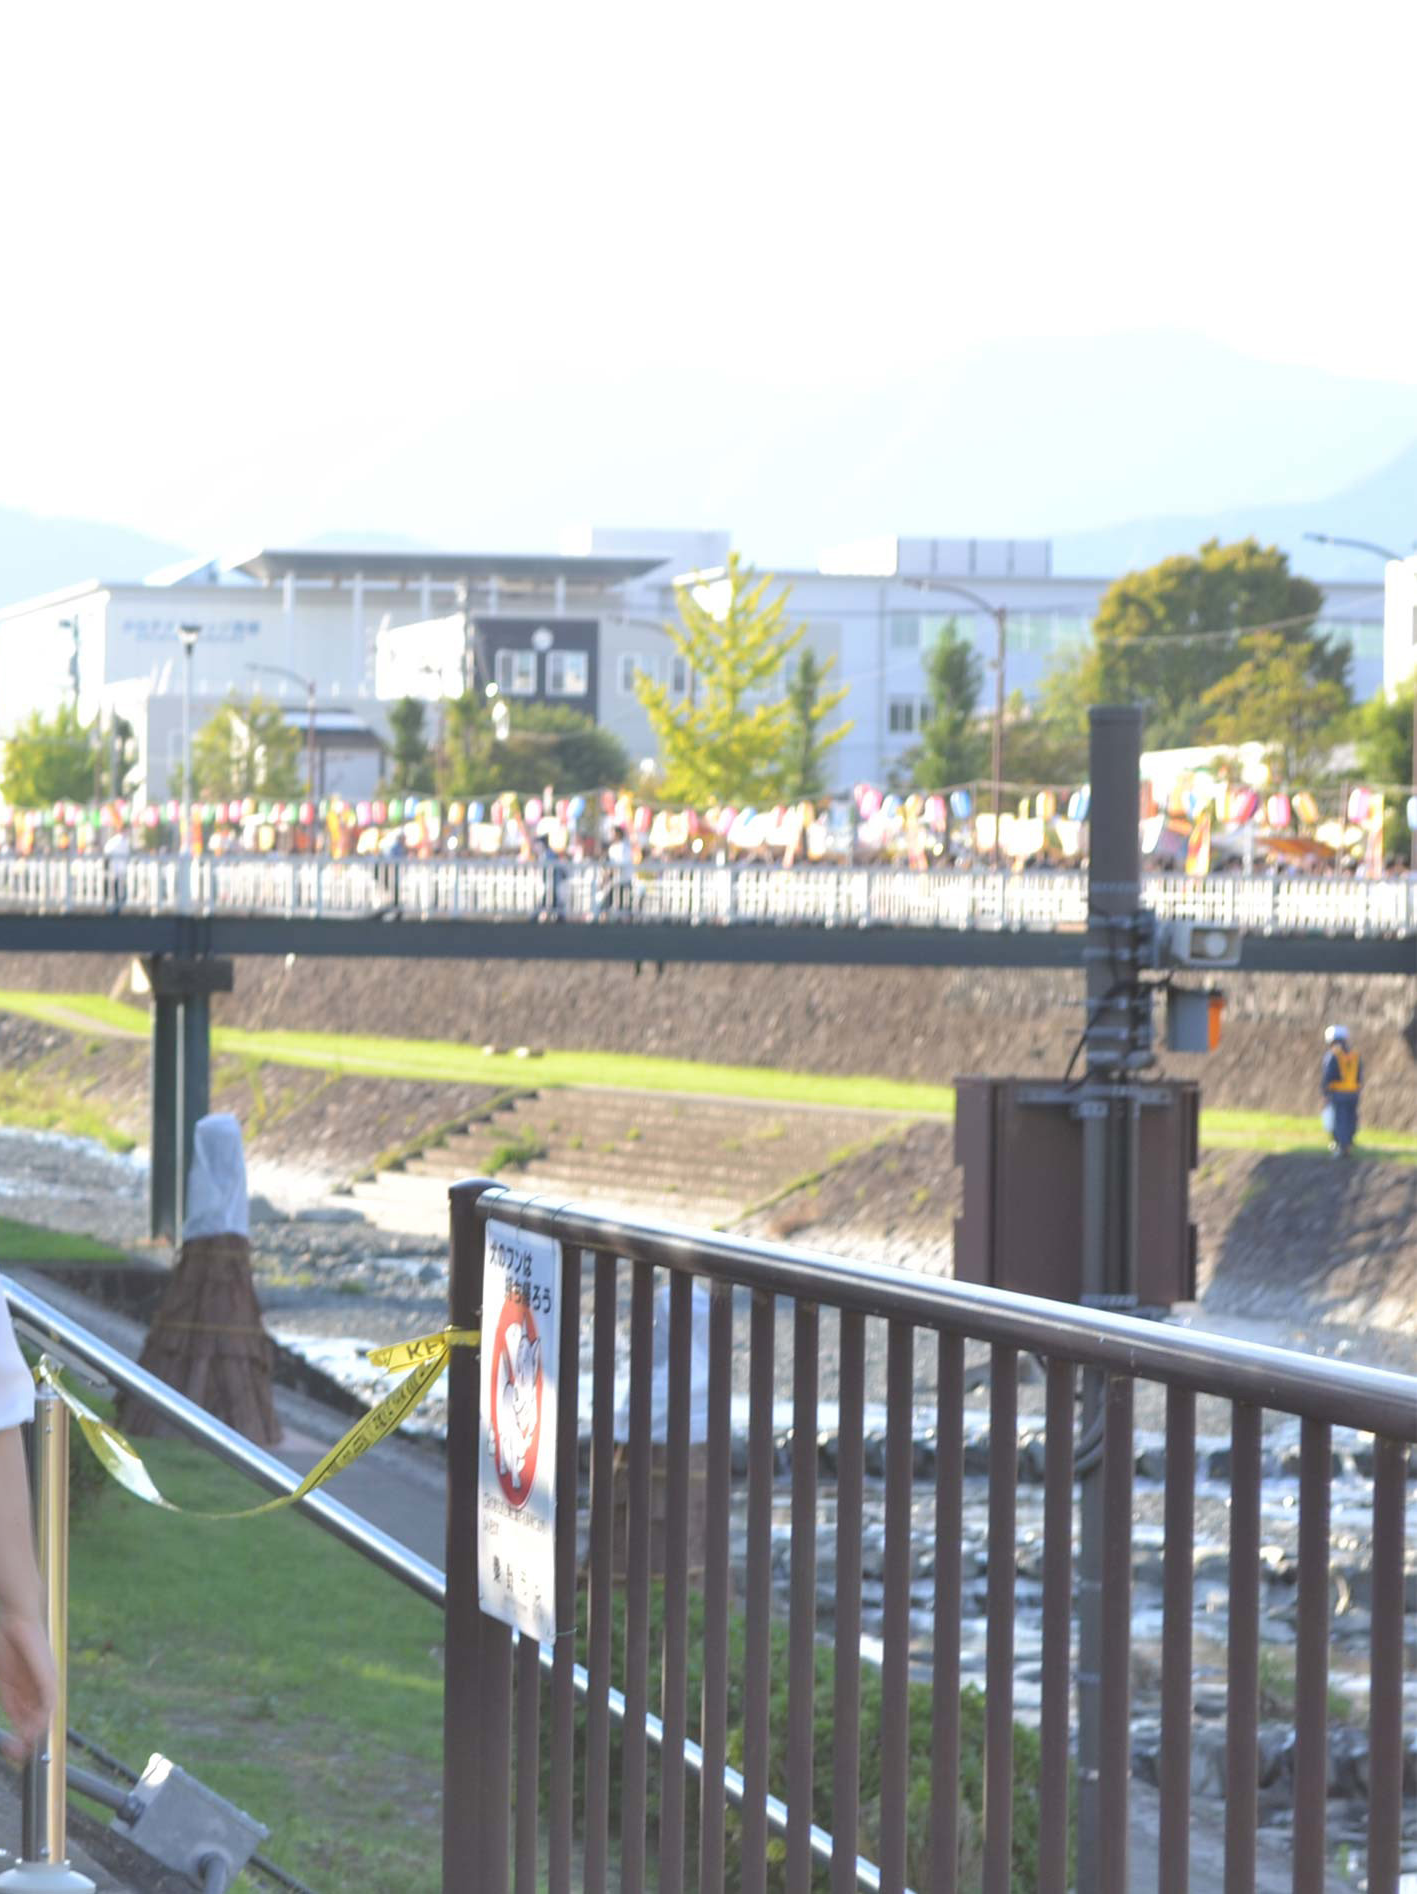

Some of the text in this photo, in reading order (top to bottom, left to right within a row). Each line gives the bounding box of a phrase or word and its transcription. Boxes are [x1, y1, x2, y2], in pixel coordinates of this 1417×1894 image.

[489, 1240, 532, 1277] 犬のフンは
